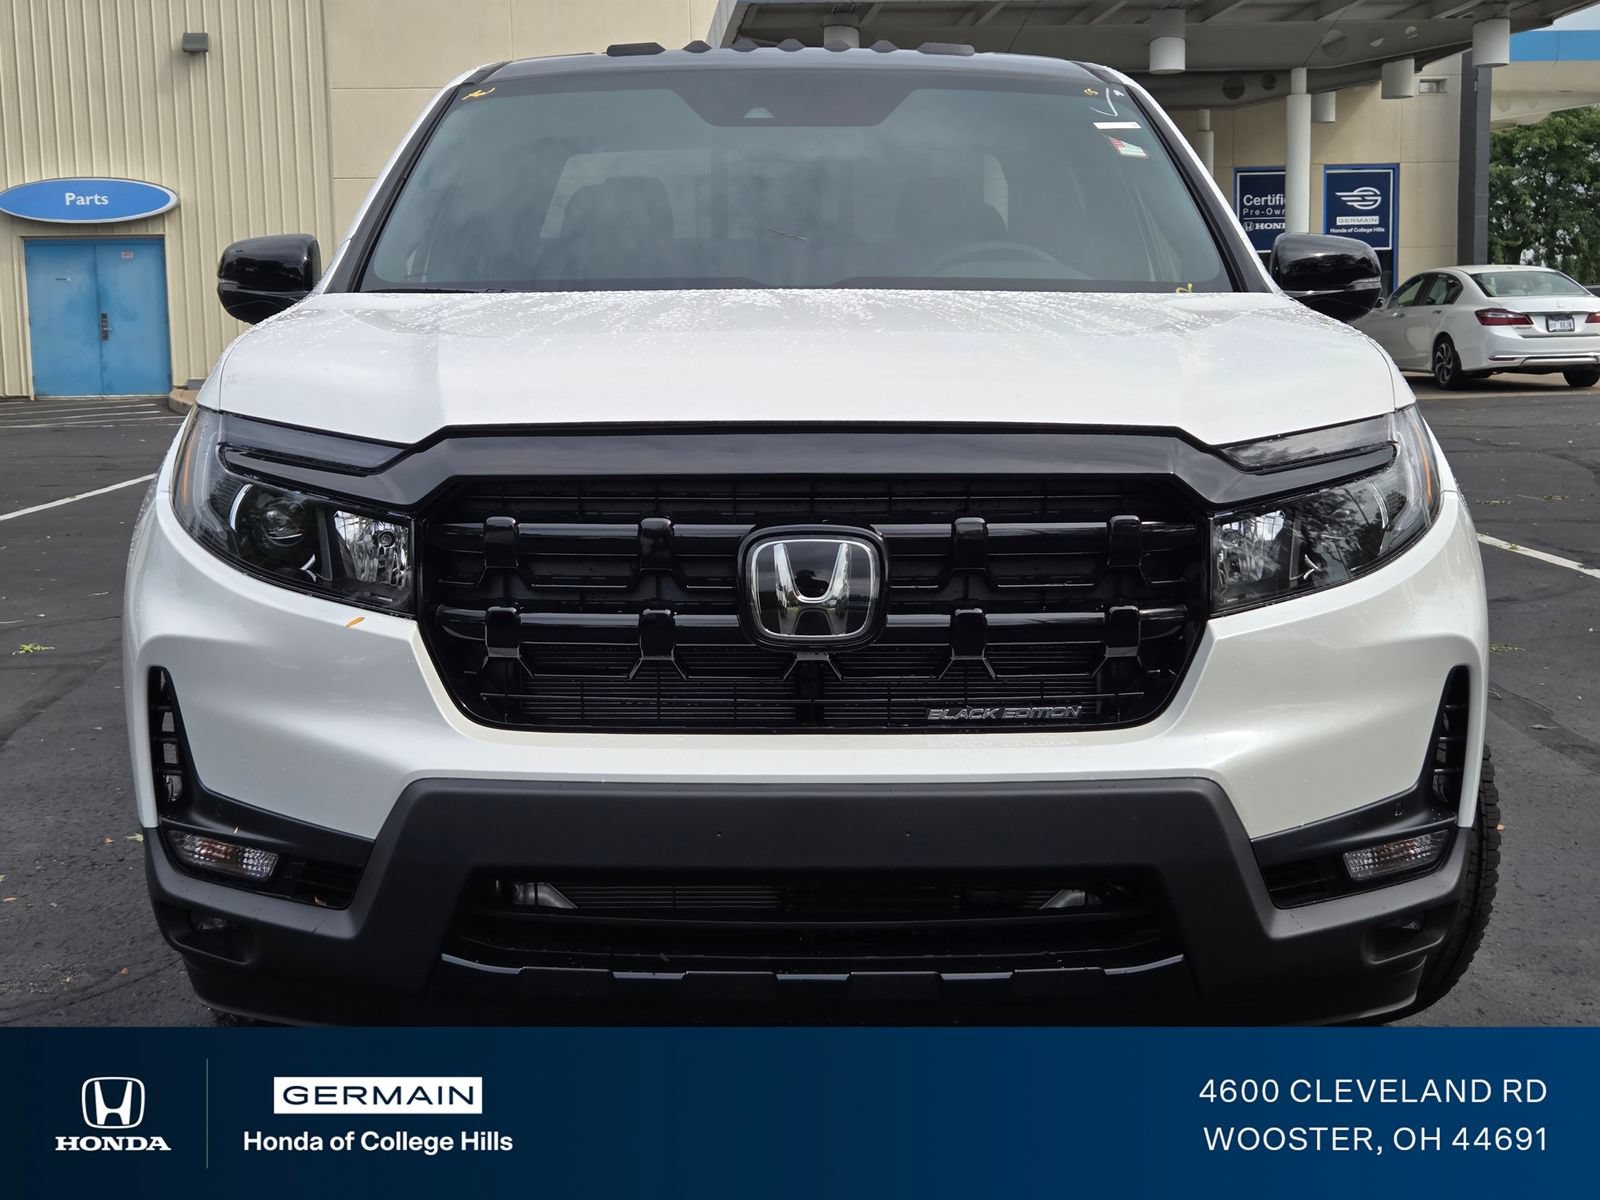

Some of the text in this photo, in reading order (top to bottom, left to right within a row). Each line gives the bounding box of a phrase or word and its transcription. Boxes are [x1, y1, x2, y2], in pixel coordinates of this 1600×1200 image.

[65, 192, 109, 206] Parts
[1243, 193, 1286, 206] Certifi
[927, 705, 1082, 720] BLACK EDITION
